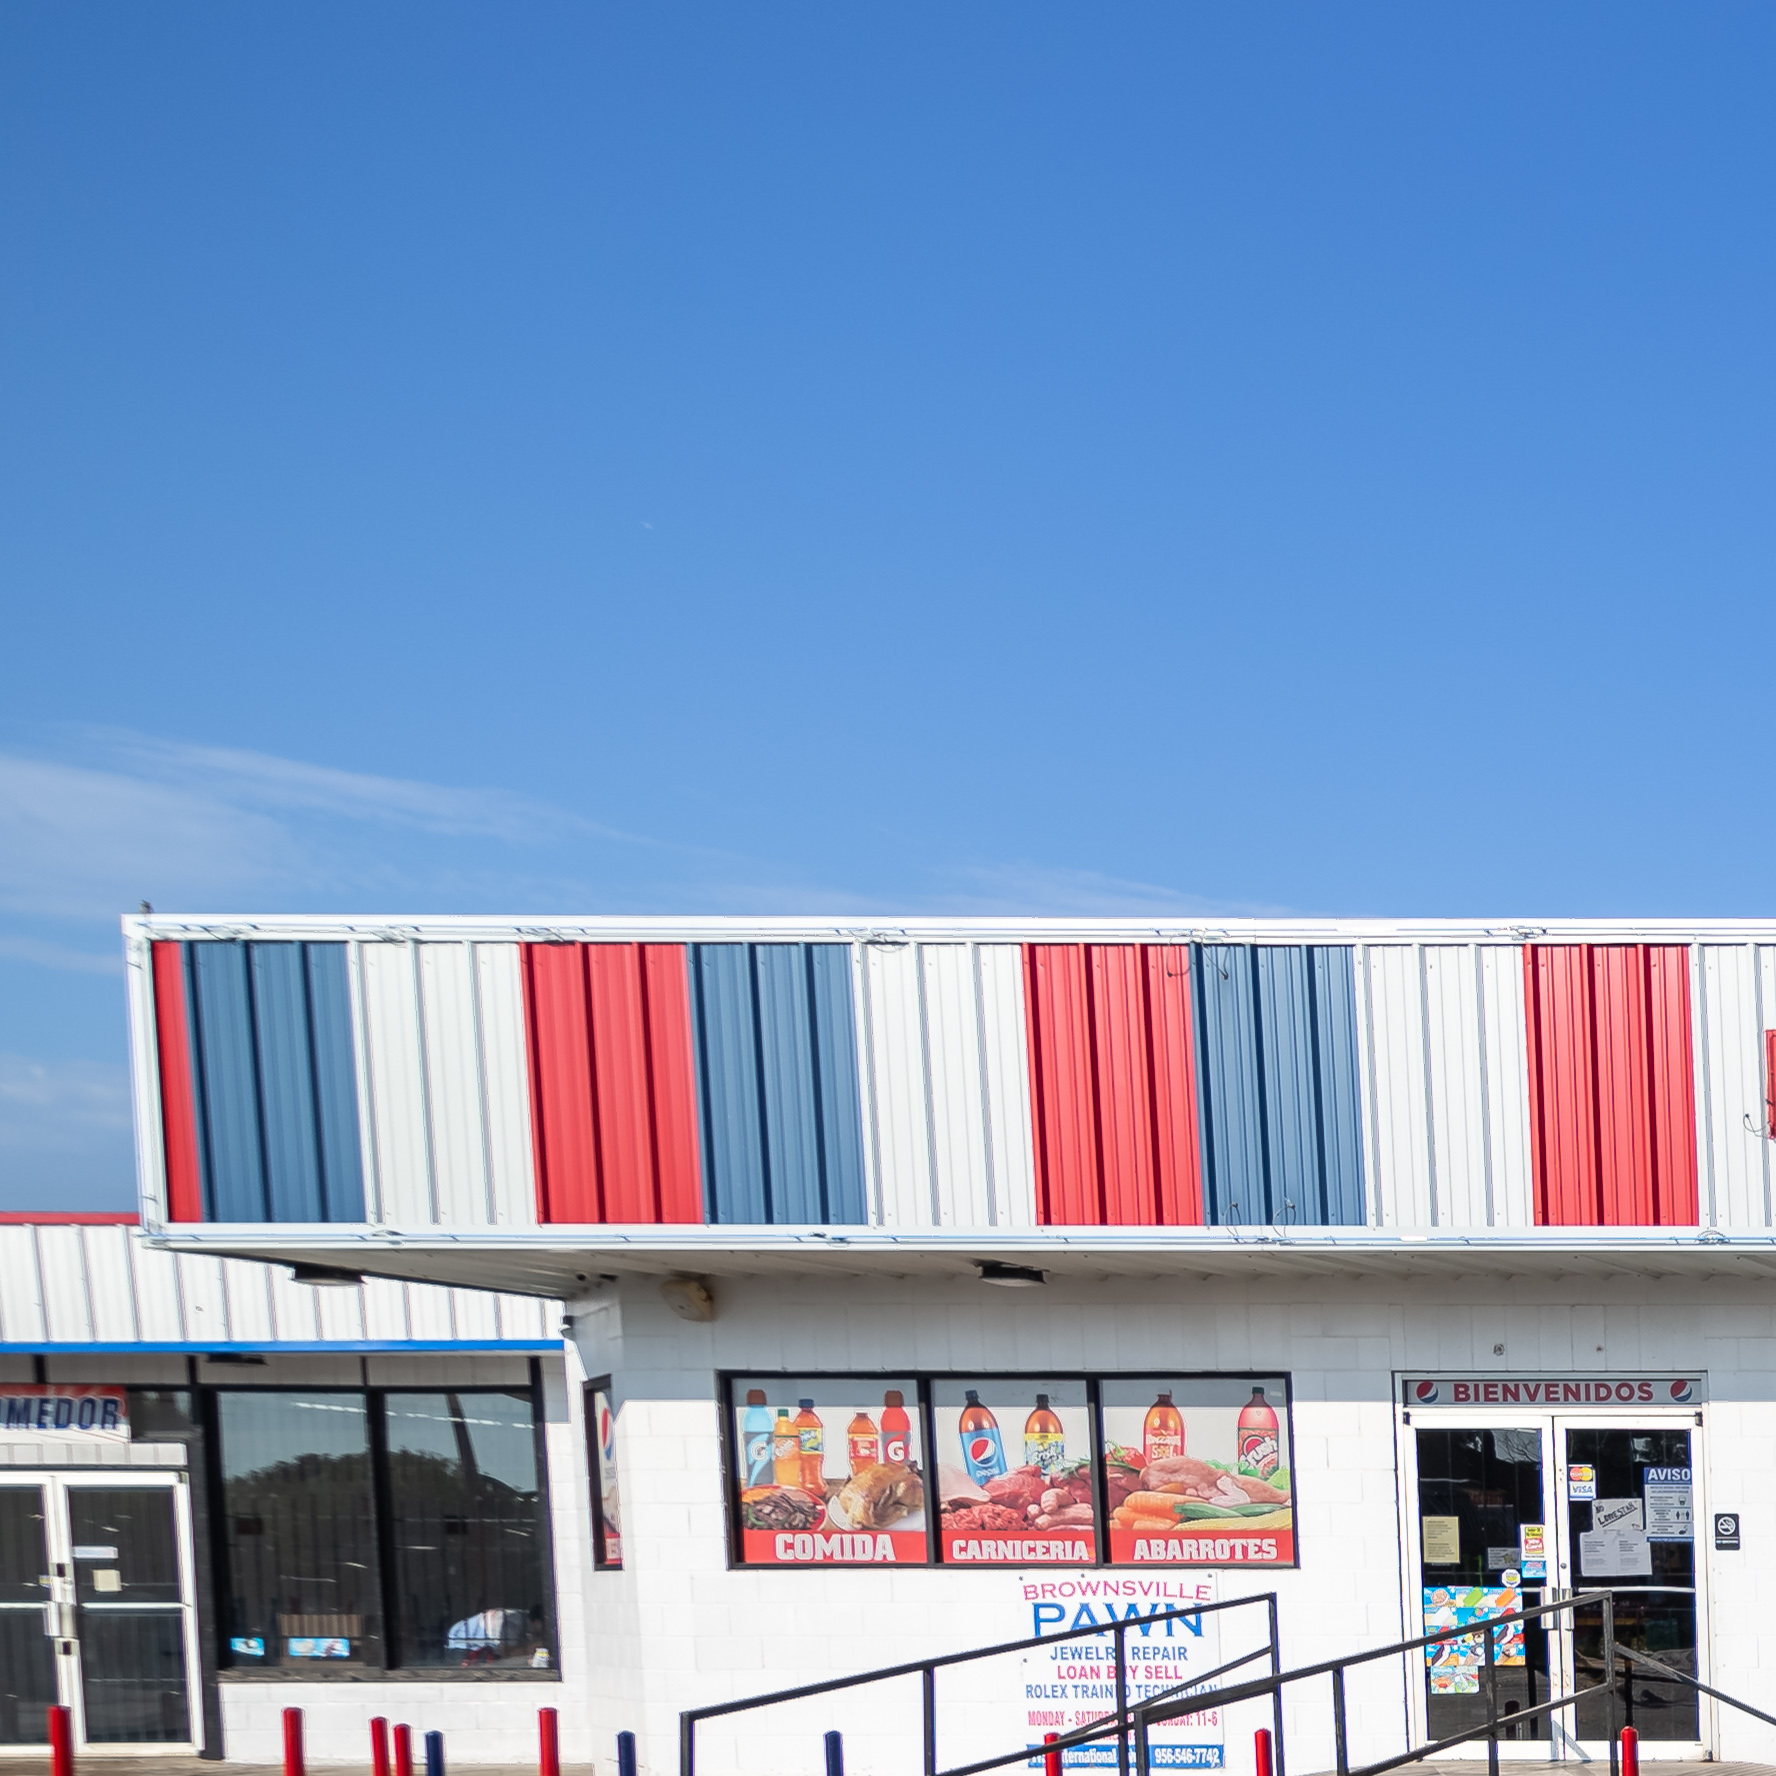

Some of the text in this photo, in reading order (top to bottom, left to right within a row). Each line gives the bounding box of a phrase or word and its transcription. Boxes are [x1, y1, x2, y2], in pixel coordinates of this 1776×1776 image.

[1453, 1381, 1654, 1402] BIENVENIDOS
[887, 1441, 905, 1461] G
[1647, 1468, 1691, 1481] AVISO
[1572, 1485, 1593, 1494] VISA
[775, 1533, 897, 1562] COMIDA
[952, 1539, 1090, 1562] CARNICERIA
[1133, 1538, 1279, 1562] ABARROTES
[1023, 1579, 1212, 1601] BROWNSVILLE
[1031, 1602, 1205, 1638] PAWN
[1050, 1646, 1189, 1661] JEWELR REPAIR
[1057, 1665, 1183, 1680] LOAN BY SELL
[1025, 1684, 1069, 1699] ROLEX
[1071, 1684, 1132, 1699] TRAIND
[1028, 1710, 1066, 1727] MONDAY
[1196, 1711, 1218, 1727] 11-6
[1154, 1747, 1220, 1765] 956-546-7742
